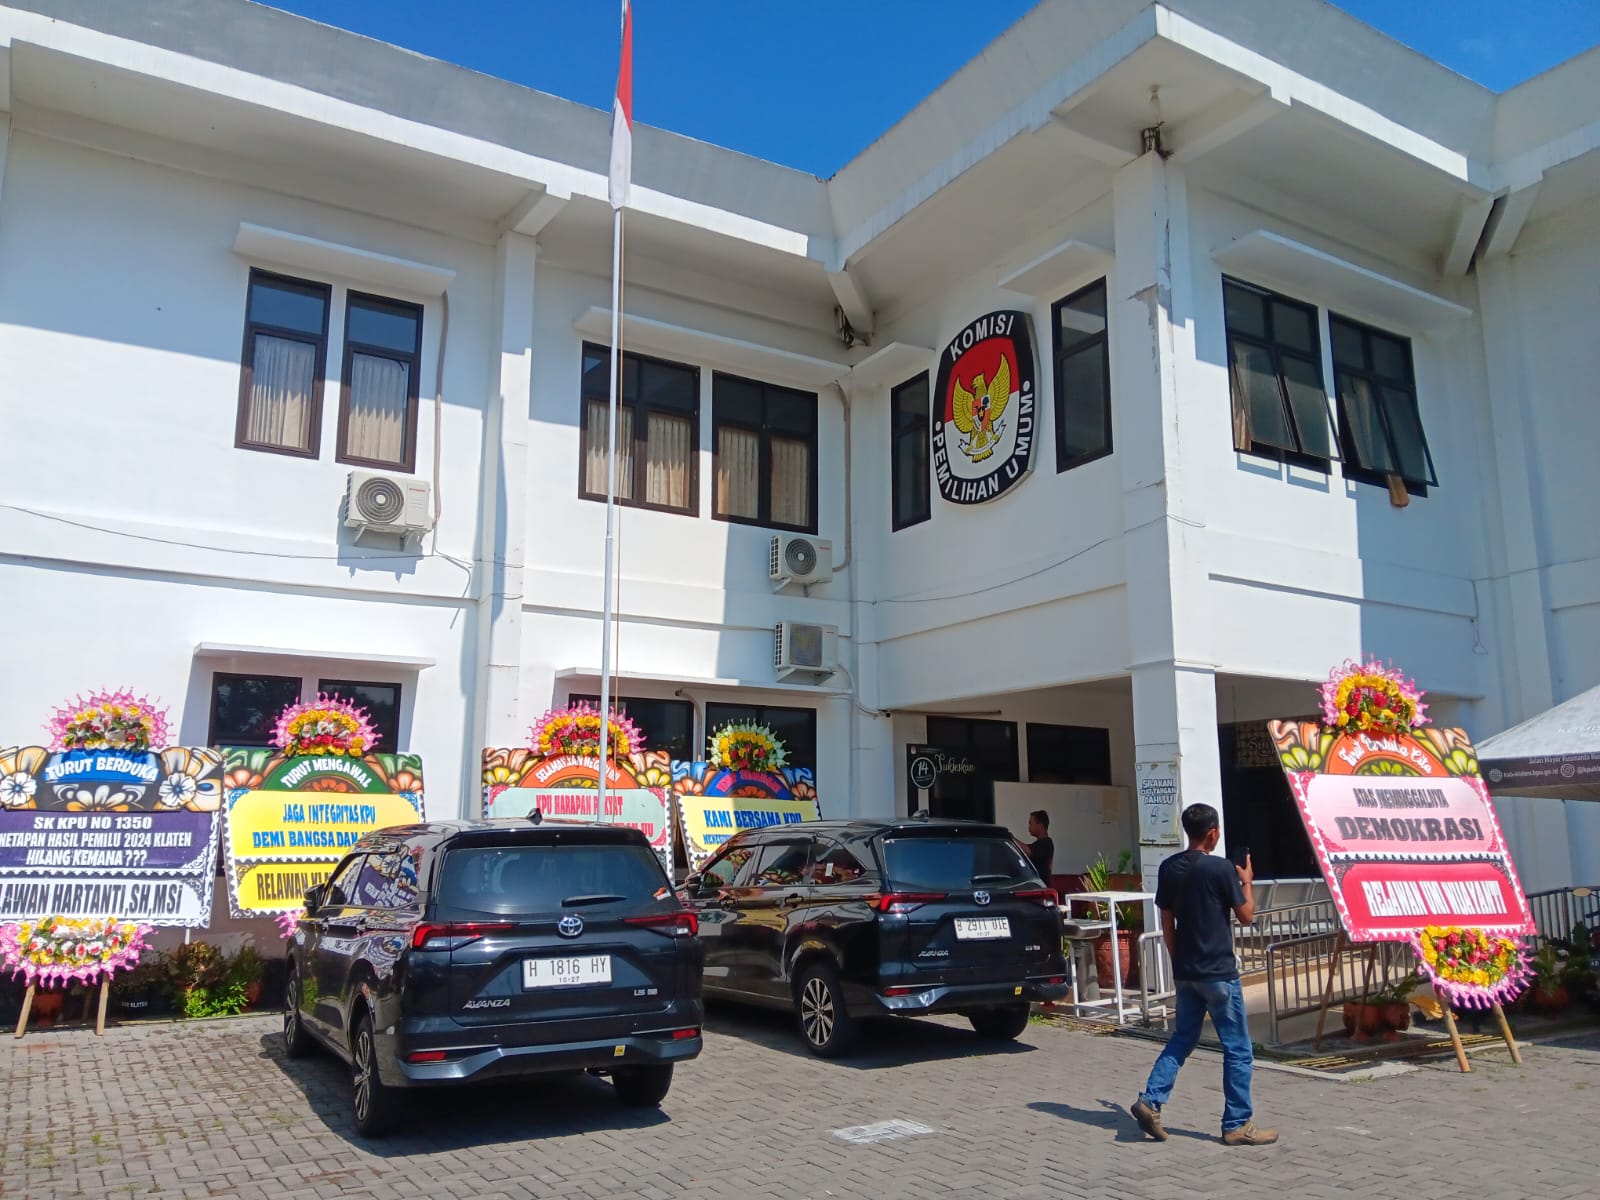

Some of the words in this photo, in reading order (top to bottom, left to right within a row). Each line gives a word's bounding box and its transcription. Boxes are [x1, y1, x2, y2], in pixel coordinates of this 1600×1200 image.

[951, 314, 1014, 362] KOMISI
[933, 431, 999, 501] PEMILIHAN
[1005, 393, 1033, 478] UMUM
[45, 758, 93, 780] TURUT
[96, 757, 159, 781] BERDUKA
[280, 762, 311, 788] TURUT
[313, 758, 372, 788] MENGAWAL
[283, 803, 305, 823] JAGA
[308, 804, 359, 824] INTEGRITAS
[360, 804, 376, 824] KPU
[554, 795, 591, 815] HARAPAN
[594, 796, 623, 815] RKYAT
[34, 817, 53, 829] SK
[57, 817, 88, 829] KPU
[91, 817, 111, 829] NO
[115, 817, 152, 829] 1350
[704, 810, 732, 827] KAMI
[734, 810, 782, 829] BERSAMA
[1335, 816, 1484, 841] DEMOKRASI
[47, 833, 78, 847] HASIL
[81, 833, 121, 847] PEMILU
[124, 833, 151, 847] 2024
[153, 832, 192, 847] KLATEN
[252, 831, 285, 848] DEMI
[288, 831, 334, 848] BANGSA
[26, 850, 71, 865] HILANG
[72, 850, 123, 866] KEMANA
[257, 872, 309, 900] RELAWAN
[0, 884, 49, 914] AWAN
[529, 961, 538, 977] H
[550, 958, 580, 976] 1816
[591, 957, 606, 974] HY
[463, 998, 511, 1009] AVANZA
